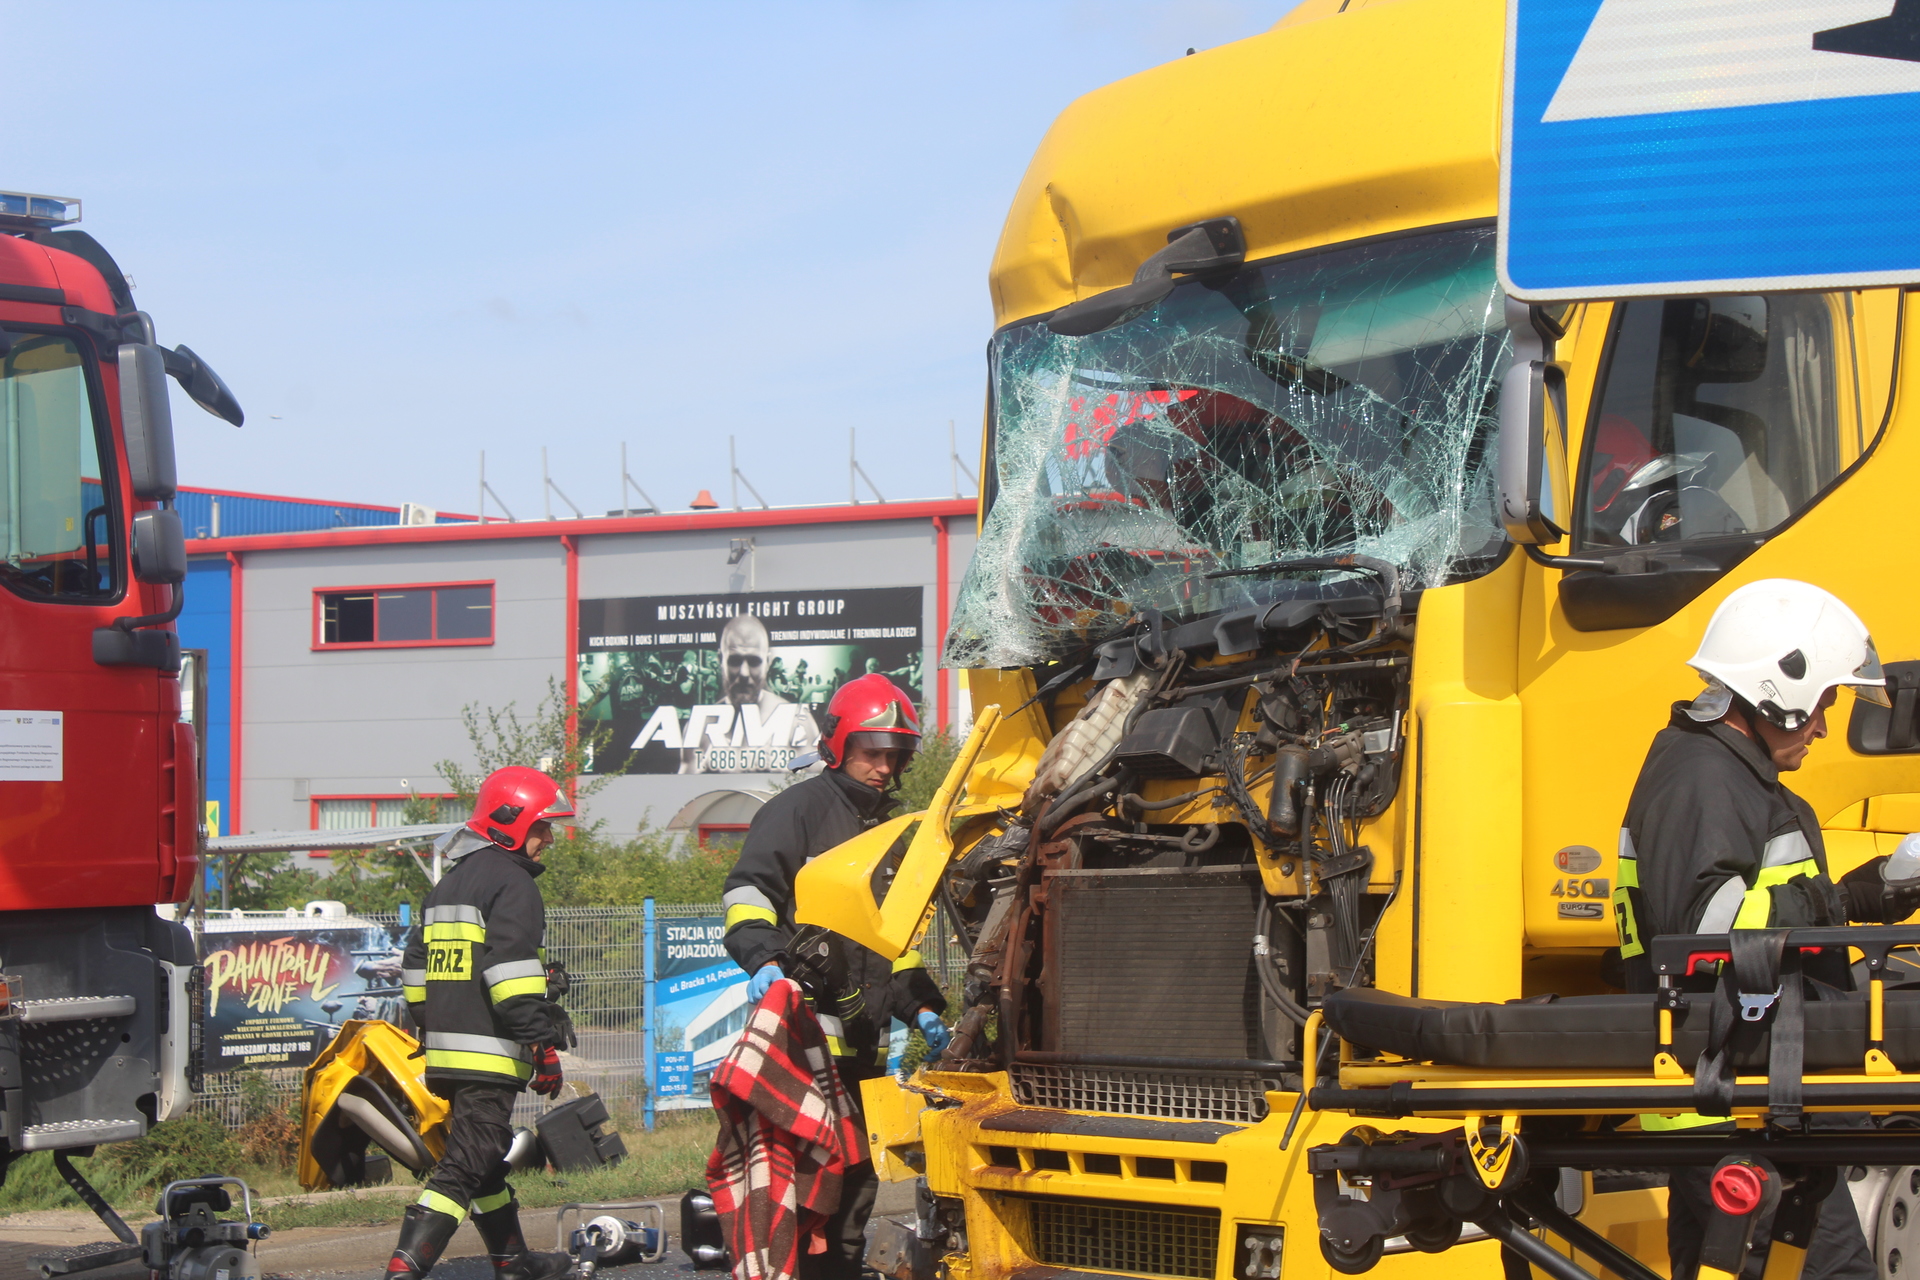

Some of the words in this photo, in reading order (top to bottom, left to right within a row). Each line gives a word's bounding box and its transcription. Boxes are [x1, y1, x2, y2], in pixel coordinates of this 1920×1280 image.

[657, 601, 741, 621] MUSZYŃSKI
[747, 601, 790, 617] FIGHT
[797, 599, 845, 615] GROUP
[589, 636, 604, 647] KICK
[605, 636, 628, 647] BOXING
[635, 634, 652, 645] BOKS
[659, 633, 677, 645] MUAY
[678, 632, 693, 644] THAI
[700, 632, 717, 643] MMA
[770, 630, 798, 641] TRENINGI
[799, 628, 846, 640] INDYWIDUALNE
[852, 628, 881, 639] TRENINGI
[882, 627, 895, 638] DLA
[896, 626, 917, 638] DZIECI
[695, 751, 705, 769] T:
[710, 750, 735, 768] 886
[740, 750, 766, 768] 576
[1550, 878, 1597, 898] 450
[666, 926, 705, 941] STACJA
[667, 939, 727, 959] POJAZDÓW
[203, 936, 340, 1018] PAINTBALL
[669, 982, 680, 993] ul.
[681, 976, 705, 990] Bracka
[246, 981, 301, 1015] ZONE
[221, 1044, 267, 1056] ZAPRASZAMY
